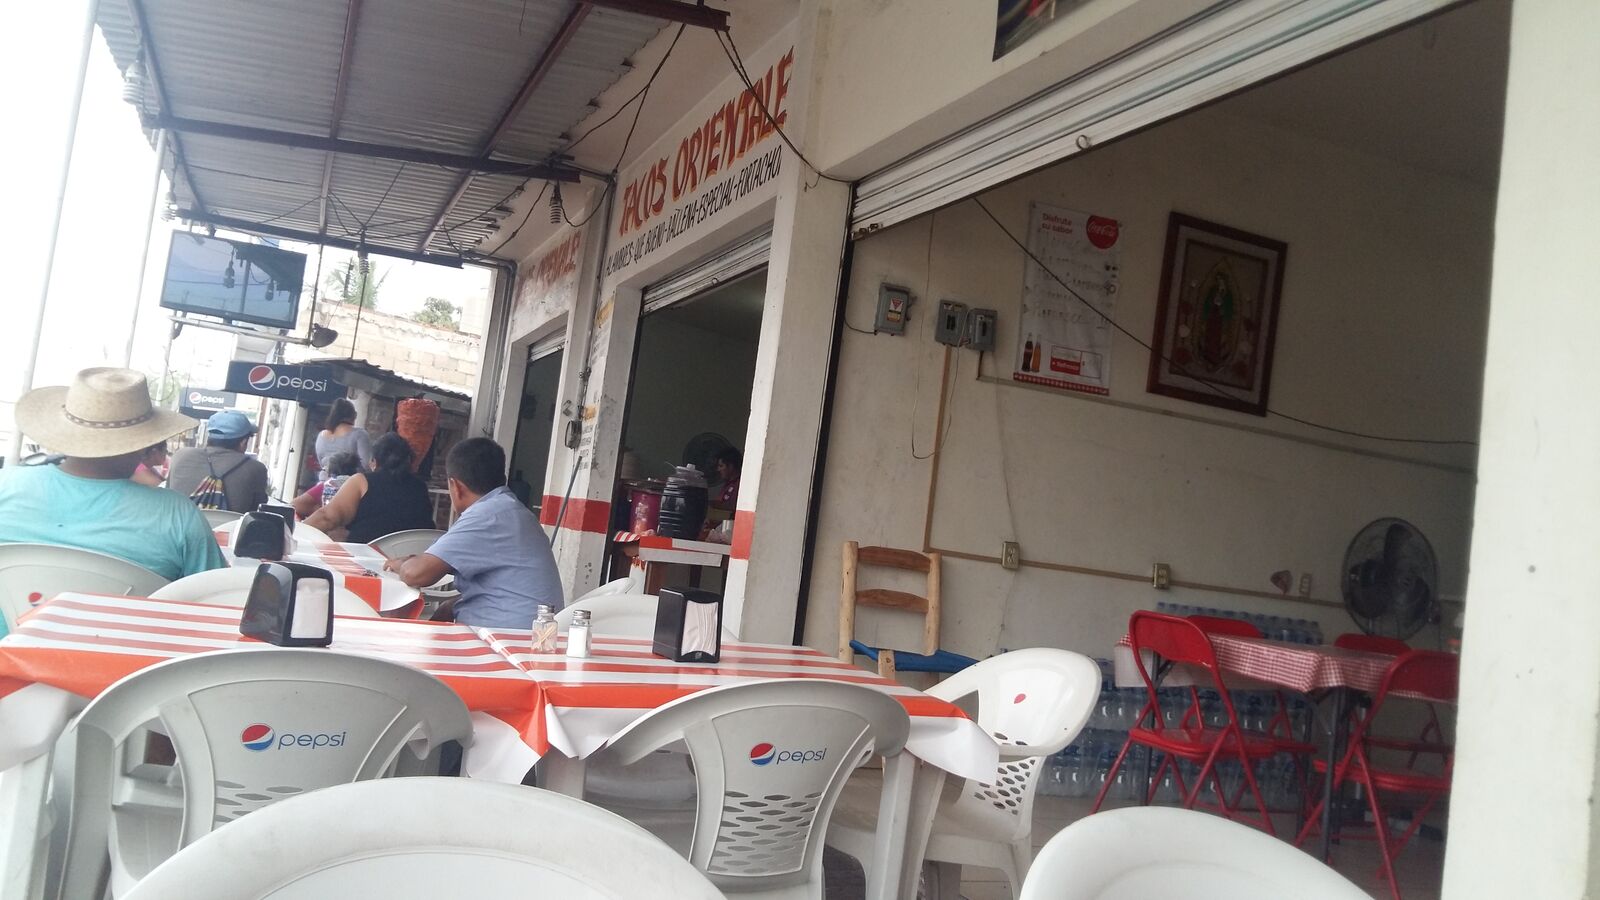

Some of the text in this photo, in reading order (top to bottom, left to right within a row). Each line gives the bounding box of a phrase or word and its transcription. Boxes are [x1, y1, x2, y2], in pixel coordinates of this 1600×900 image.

[619, 154, 670, 236] TACOS
[277, 375, 328, 392] pepsi
[201, 394, 225, 405] pepsi
[278, 731, 346, 750] pepsi
[777, 747, 827, 764] pepsi
